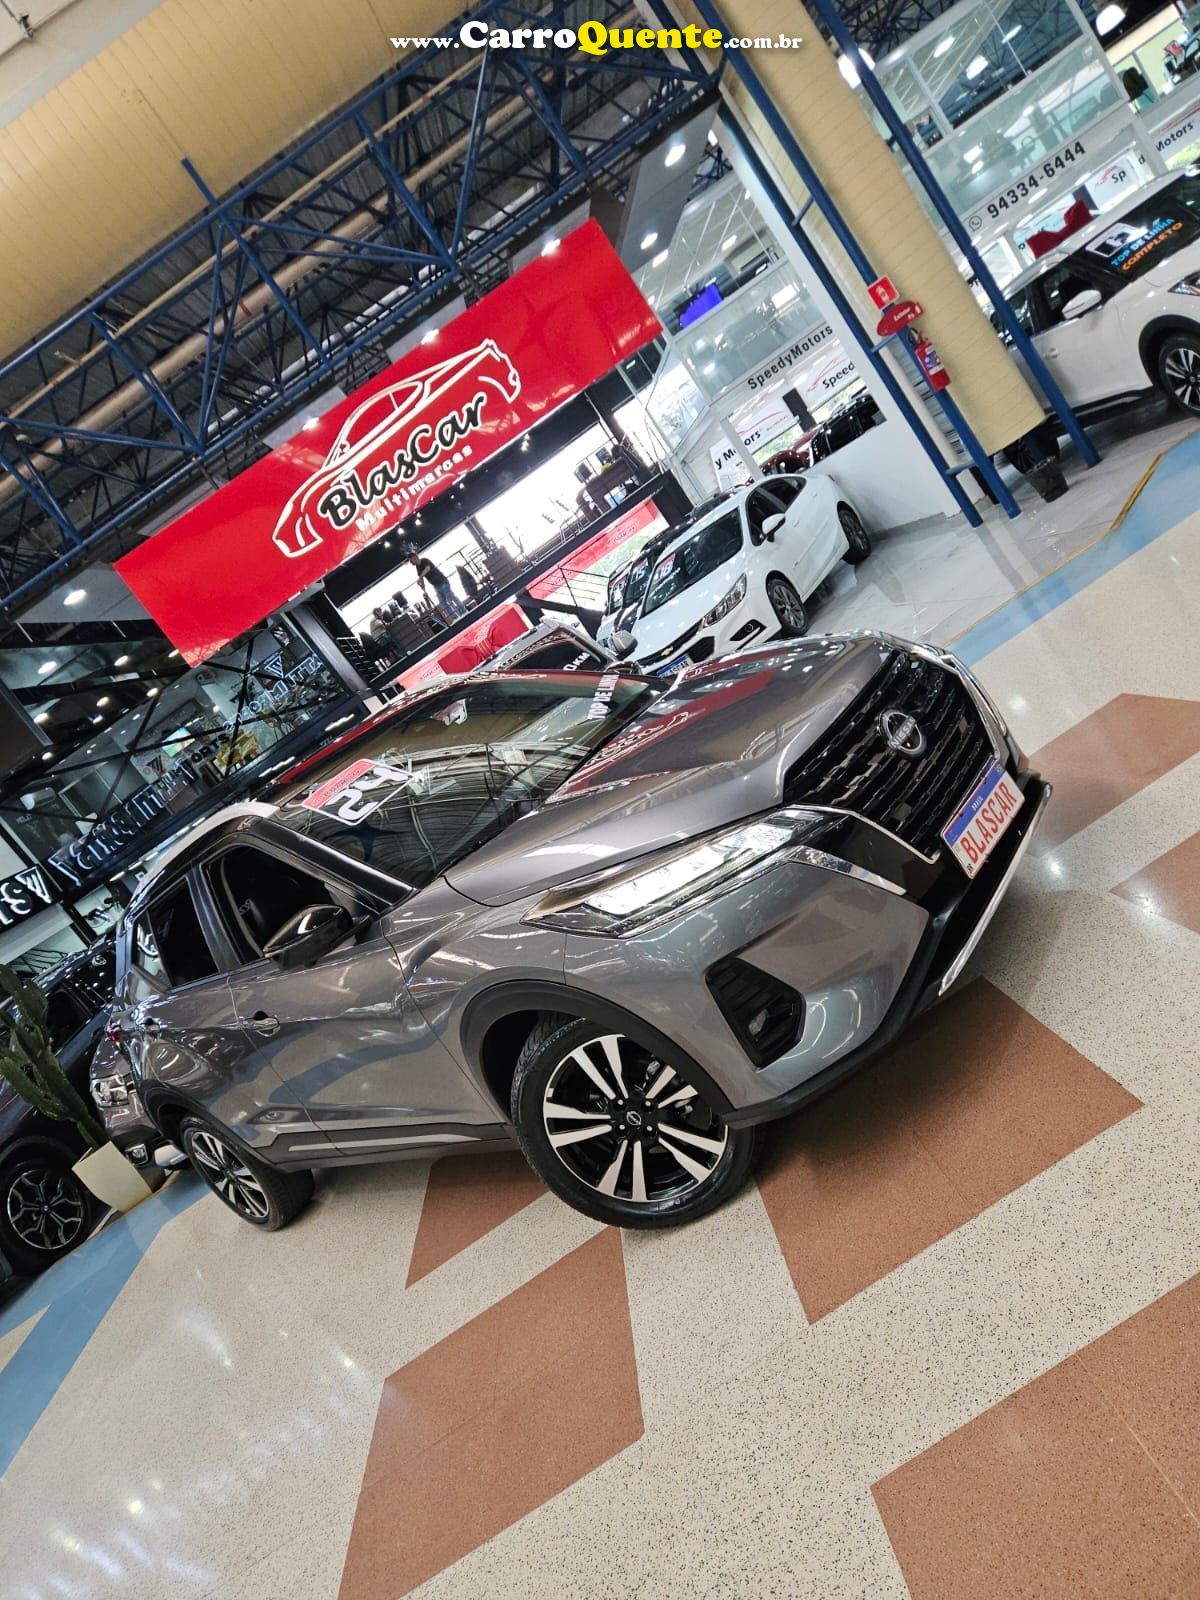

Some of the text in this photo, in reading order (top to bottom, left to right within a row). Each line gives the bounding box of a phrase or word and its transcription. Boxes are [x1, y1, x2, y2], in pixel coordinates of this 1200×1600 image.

[986, 140, 1087, 219] 94334-6444
[1110, 247, 1131, 268] TOP
[1130, 237, 1146, 251] DE
[1121, 221, 1184, 272] COMPLETO
[747, 324, 834, 391] SpeedyMotors
[317, 391, 487, 528] BlasCar
[355, 444, 473, 532] Multimarcas
[586, 702, 610, 720] TOP
[592, 691, 614, 702] DE
[888, 715, 917, 749] NISSAN
[325, 766, 410, 821] 24
[959, 781, 1018, 864] BLASCAR
